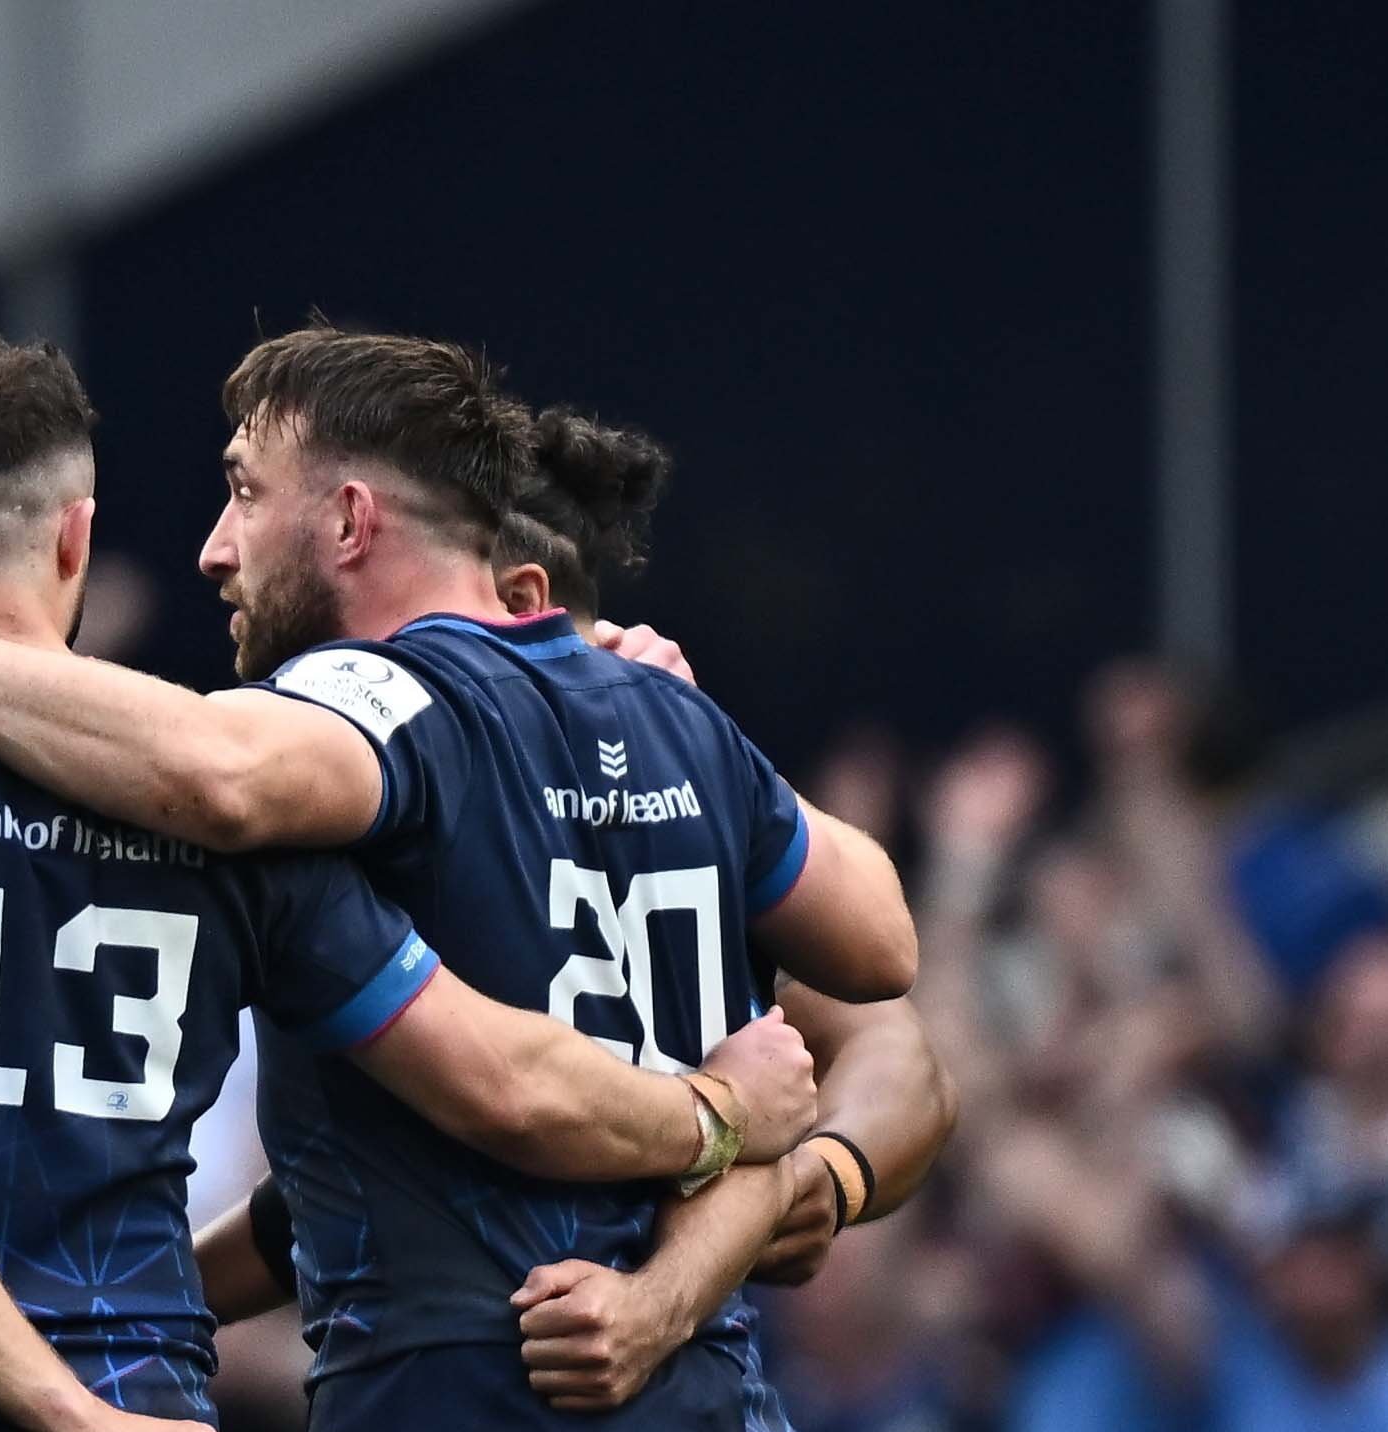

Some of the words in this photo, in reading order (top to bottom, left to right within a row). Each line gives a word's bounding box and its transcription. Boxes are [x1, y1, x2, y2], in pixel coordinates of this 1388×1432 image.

[543, 784, 591, 820] an
[588, 789, 619, 826] of
[25, 815, 68, 850] of
[548, 858, 726, 1074] 20
